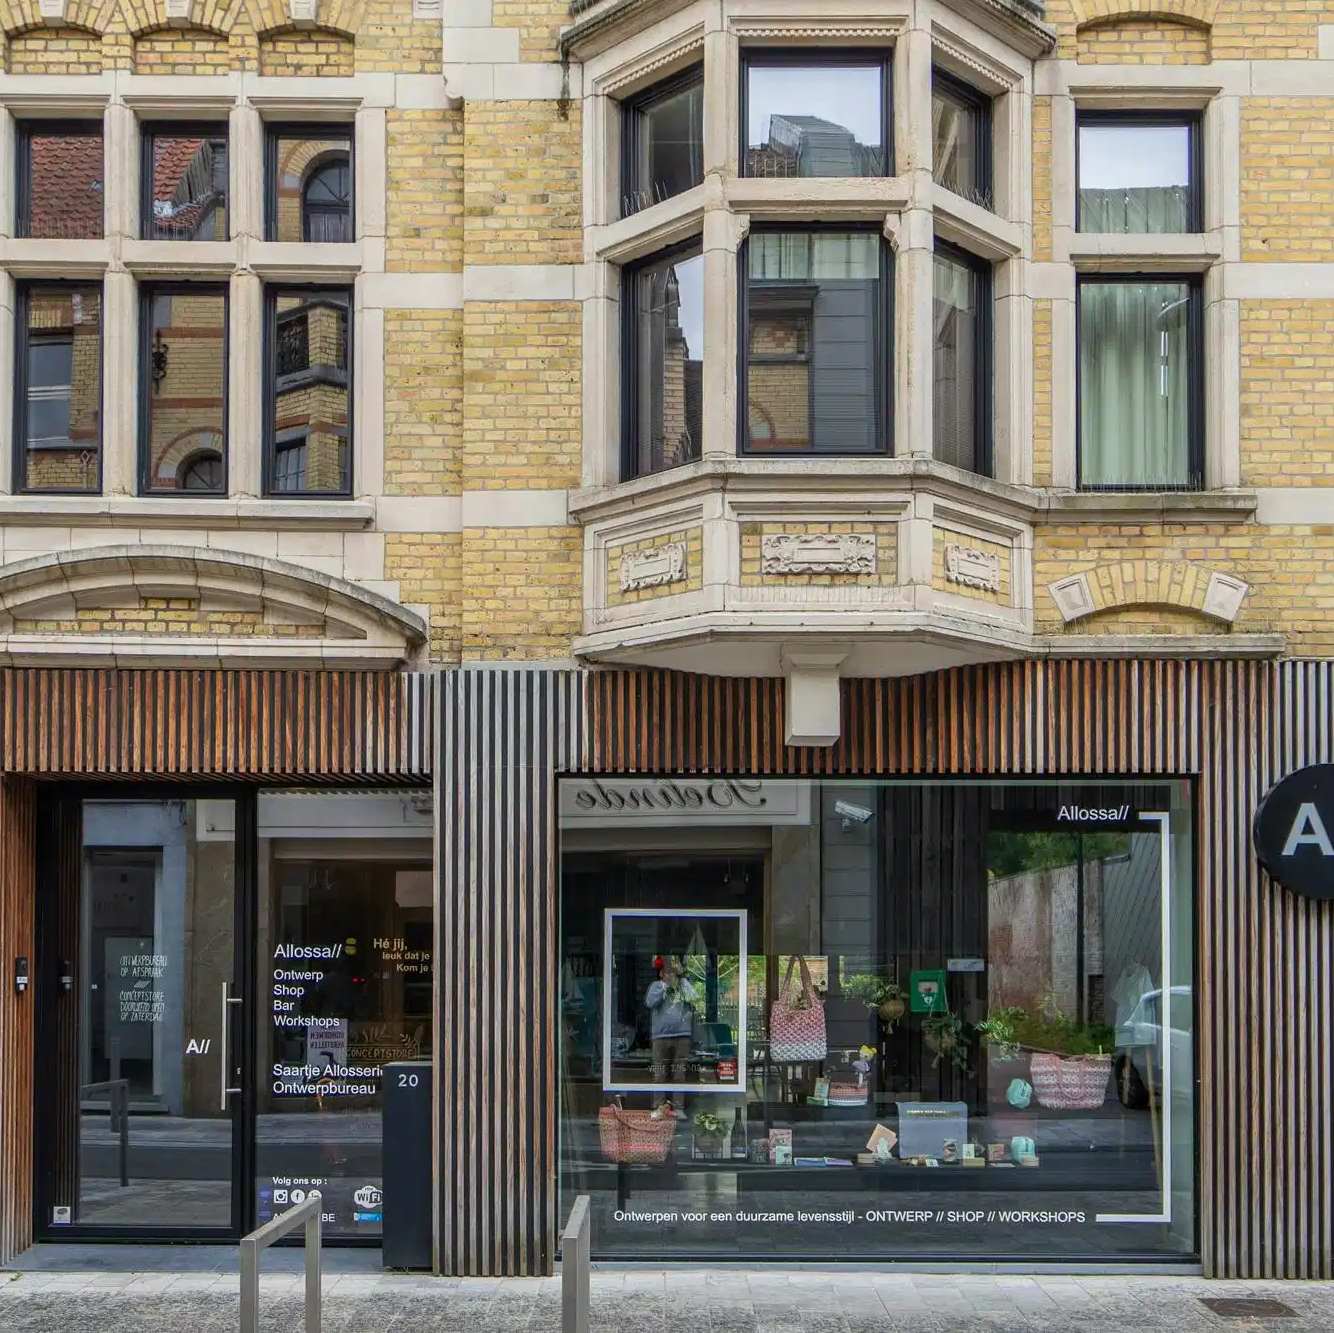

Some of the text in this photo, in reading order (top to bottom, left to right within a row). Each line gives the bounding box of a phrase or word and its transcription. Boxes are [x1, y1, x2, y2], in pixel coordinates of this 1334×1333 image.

[1057, 805, 1130, 820] Allossa//
[373, 937, 390, 949] Hé
[273, 943, 342, 959] Allossa//
[382, 951, 430, 961] leuk dat je
[396, 963, 429, 973] Kom je
[273, 969, 324, 982] Ontwerp
[273, 984, 305, 997] Shop
[273, 999, 295, 1011] Bar
[274, 1015, 340, 1028] Workshops
[346, 1048, 412, 1059] CONCEPTSTORE
[273, 1063, 320, 1078] Saartje
[398, 1074, 419, 1087] 20
[272, 1081, 376, 1096] Ontwerpbureau
[272, 1176, 292, 1186] Volg
[311, 1178, 323, 1186] op
[613, 1210, 678, 1223] Ontwerpen
[681, 1212, 707, 1222] voor
[710, 1212, 733, 1222] een
[735, 1210, 794, 1222] duurzame
[797, 1210, 855, 1223] levensstijl
[866, 1211, 933, 1223] ONTWERP
[947, 1211, 985, 1223] SHOP
[999, 1211, 1086, 1223] WORKSHOPS
